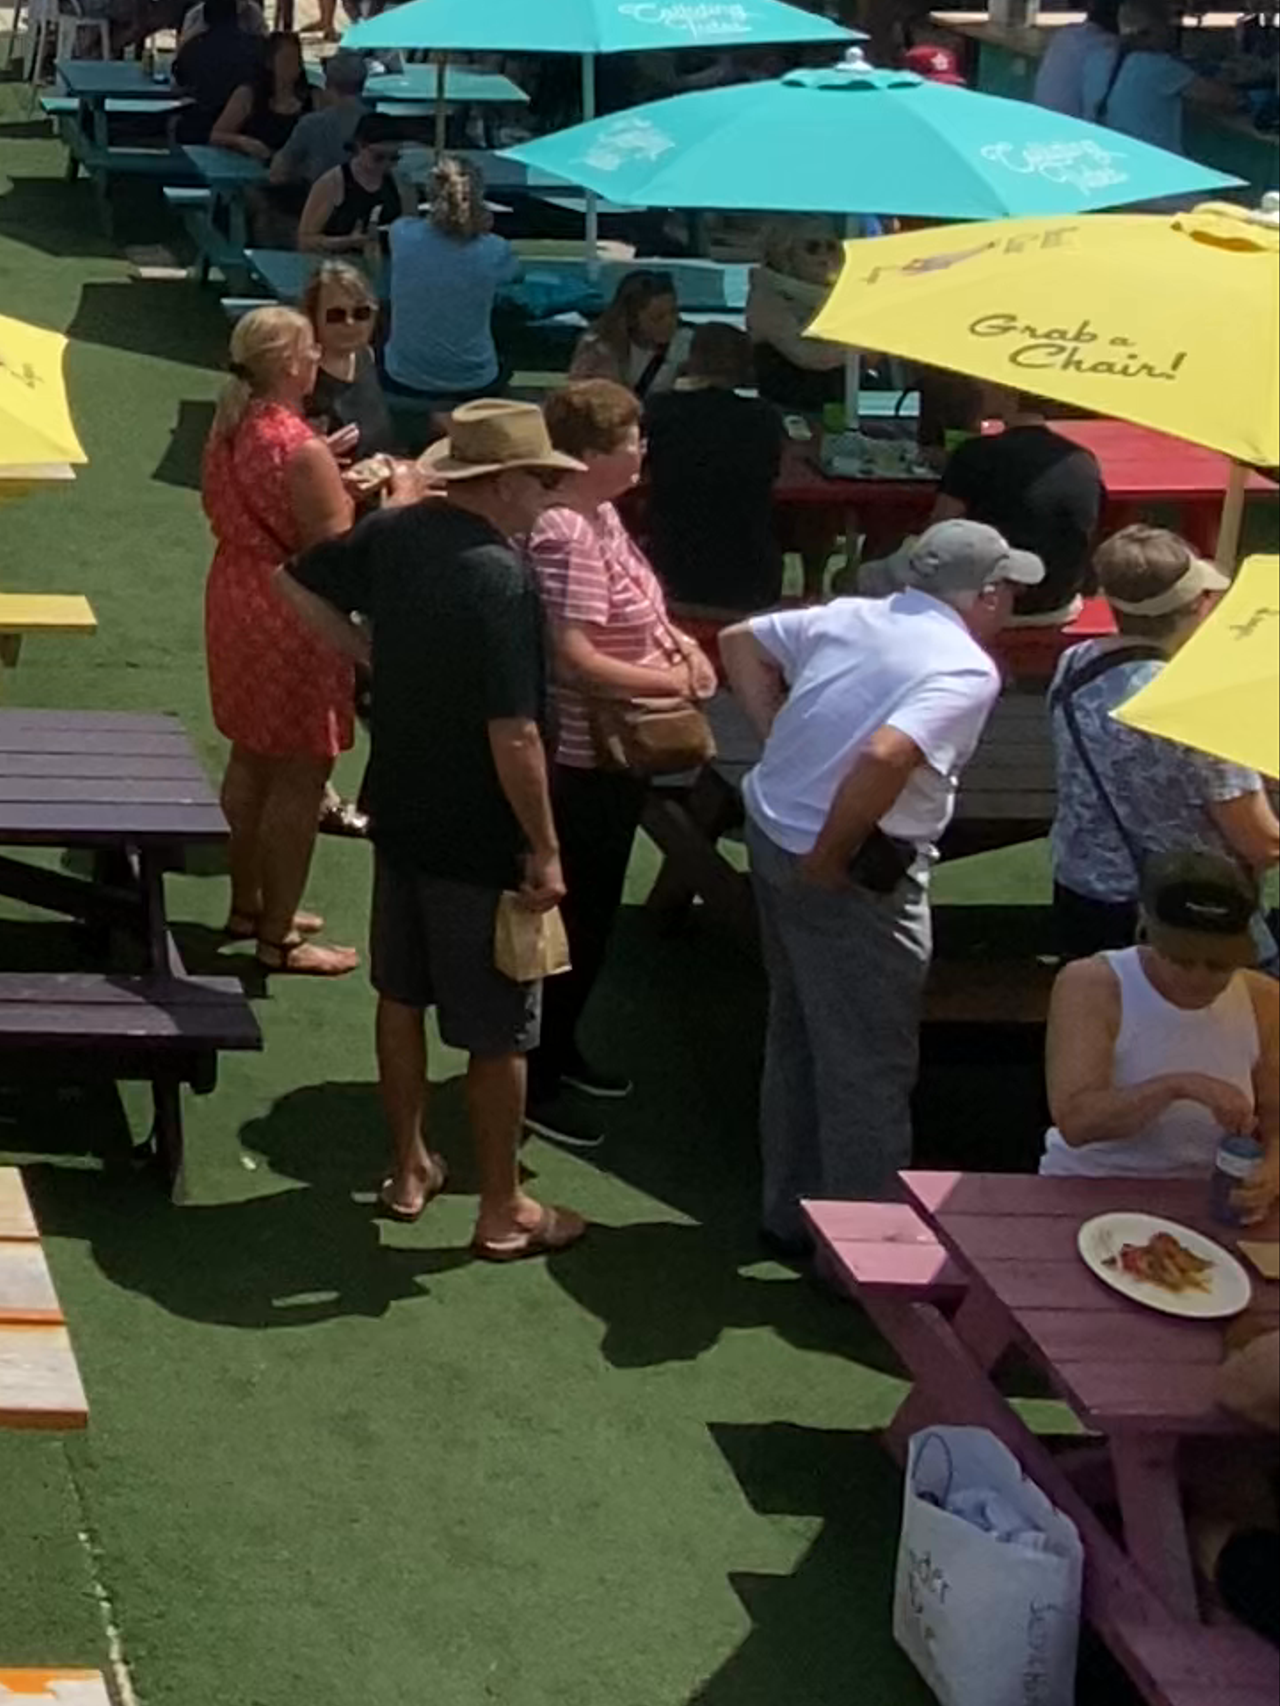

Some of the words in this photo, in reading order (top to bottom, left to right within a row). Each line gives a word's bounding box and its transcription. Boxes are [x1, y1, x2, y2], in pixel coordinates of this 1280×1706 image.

[969, 313, 1098, 344] Grab
[1110, 336, 1137, 347] a
[1009, 343, 1187, 380] Chair!
